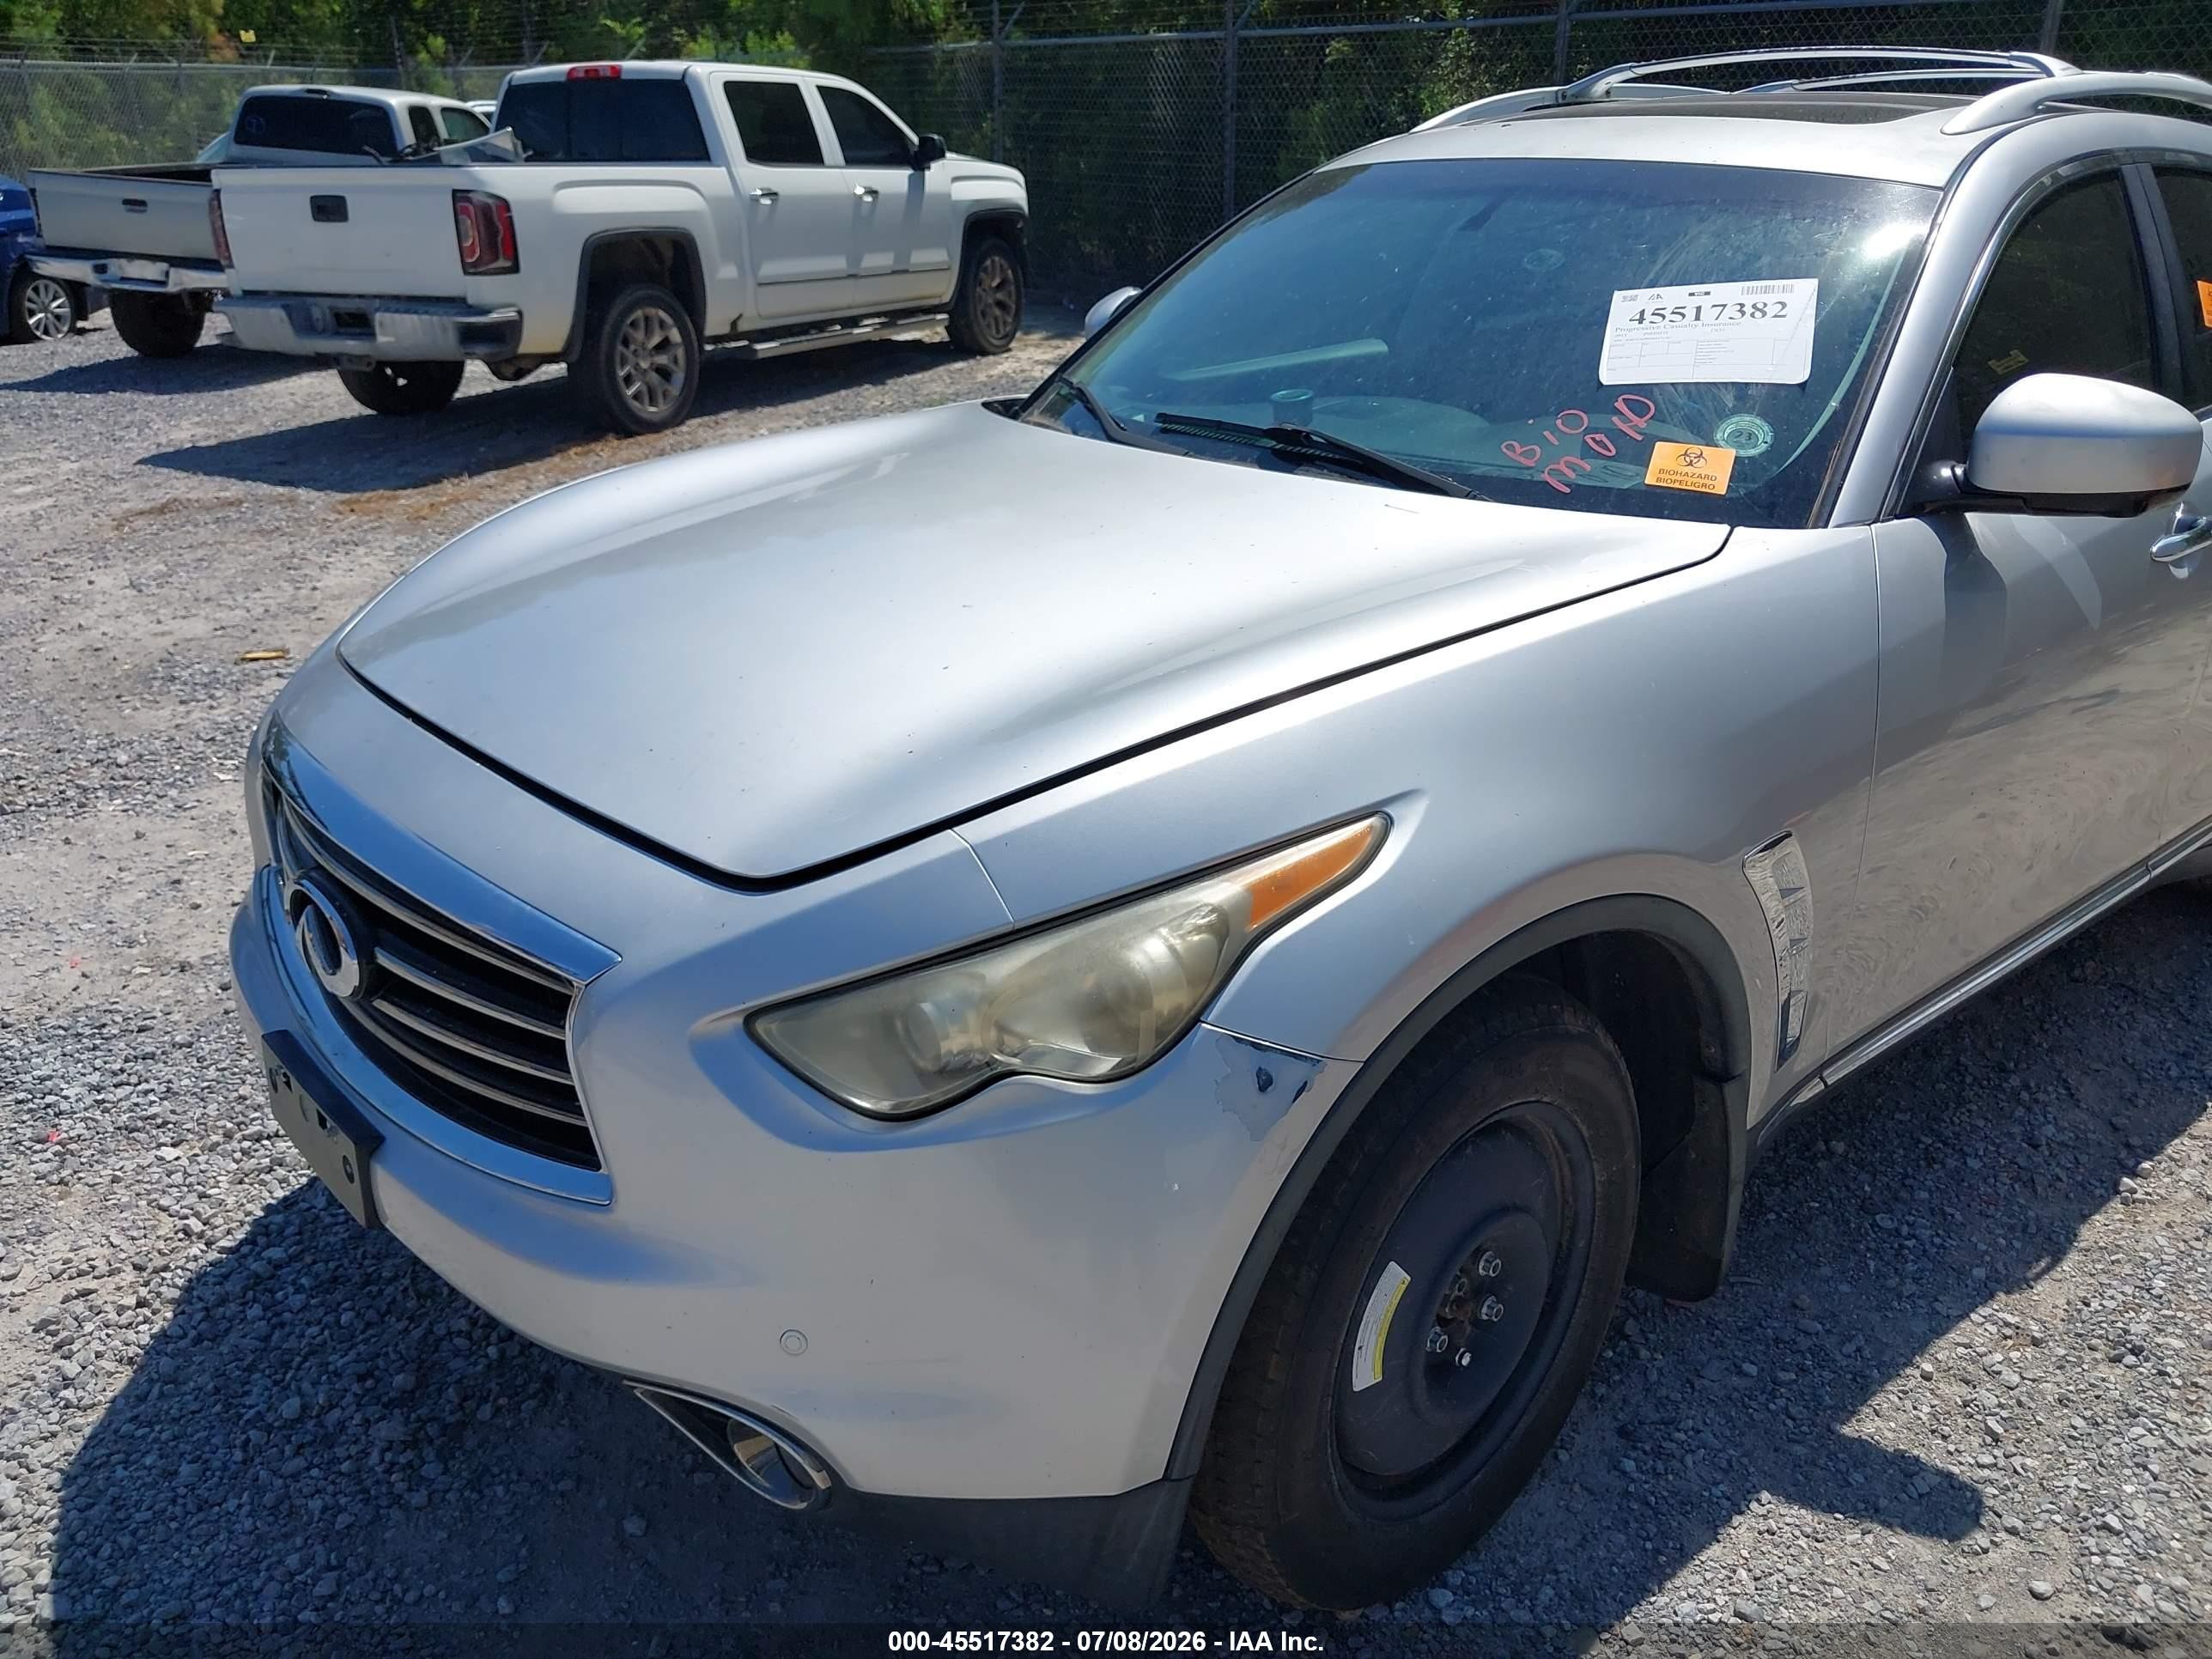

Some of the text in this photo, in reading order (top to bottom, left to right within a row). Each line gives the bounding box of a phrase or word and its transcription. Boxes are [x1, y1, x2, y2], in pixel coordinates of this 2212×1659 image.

[1628, 301, 1788, 325] 45517382
[1663, 321, 1698, 330] Casualty
[1658, 468, 1717, 482] BIOHAZARD
[1656, 477, 1716, 490] BIOPELIGRO
